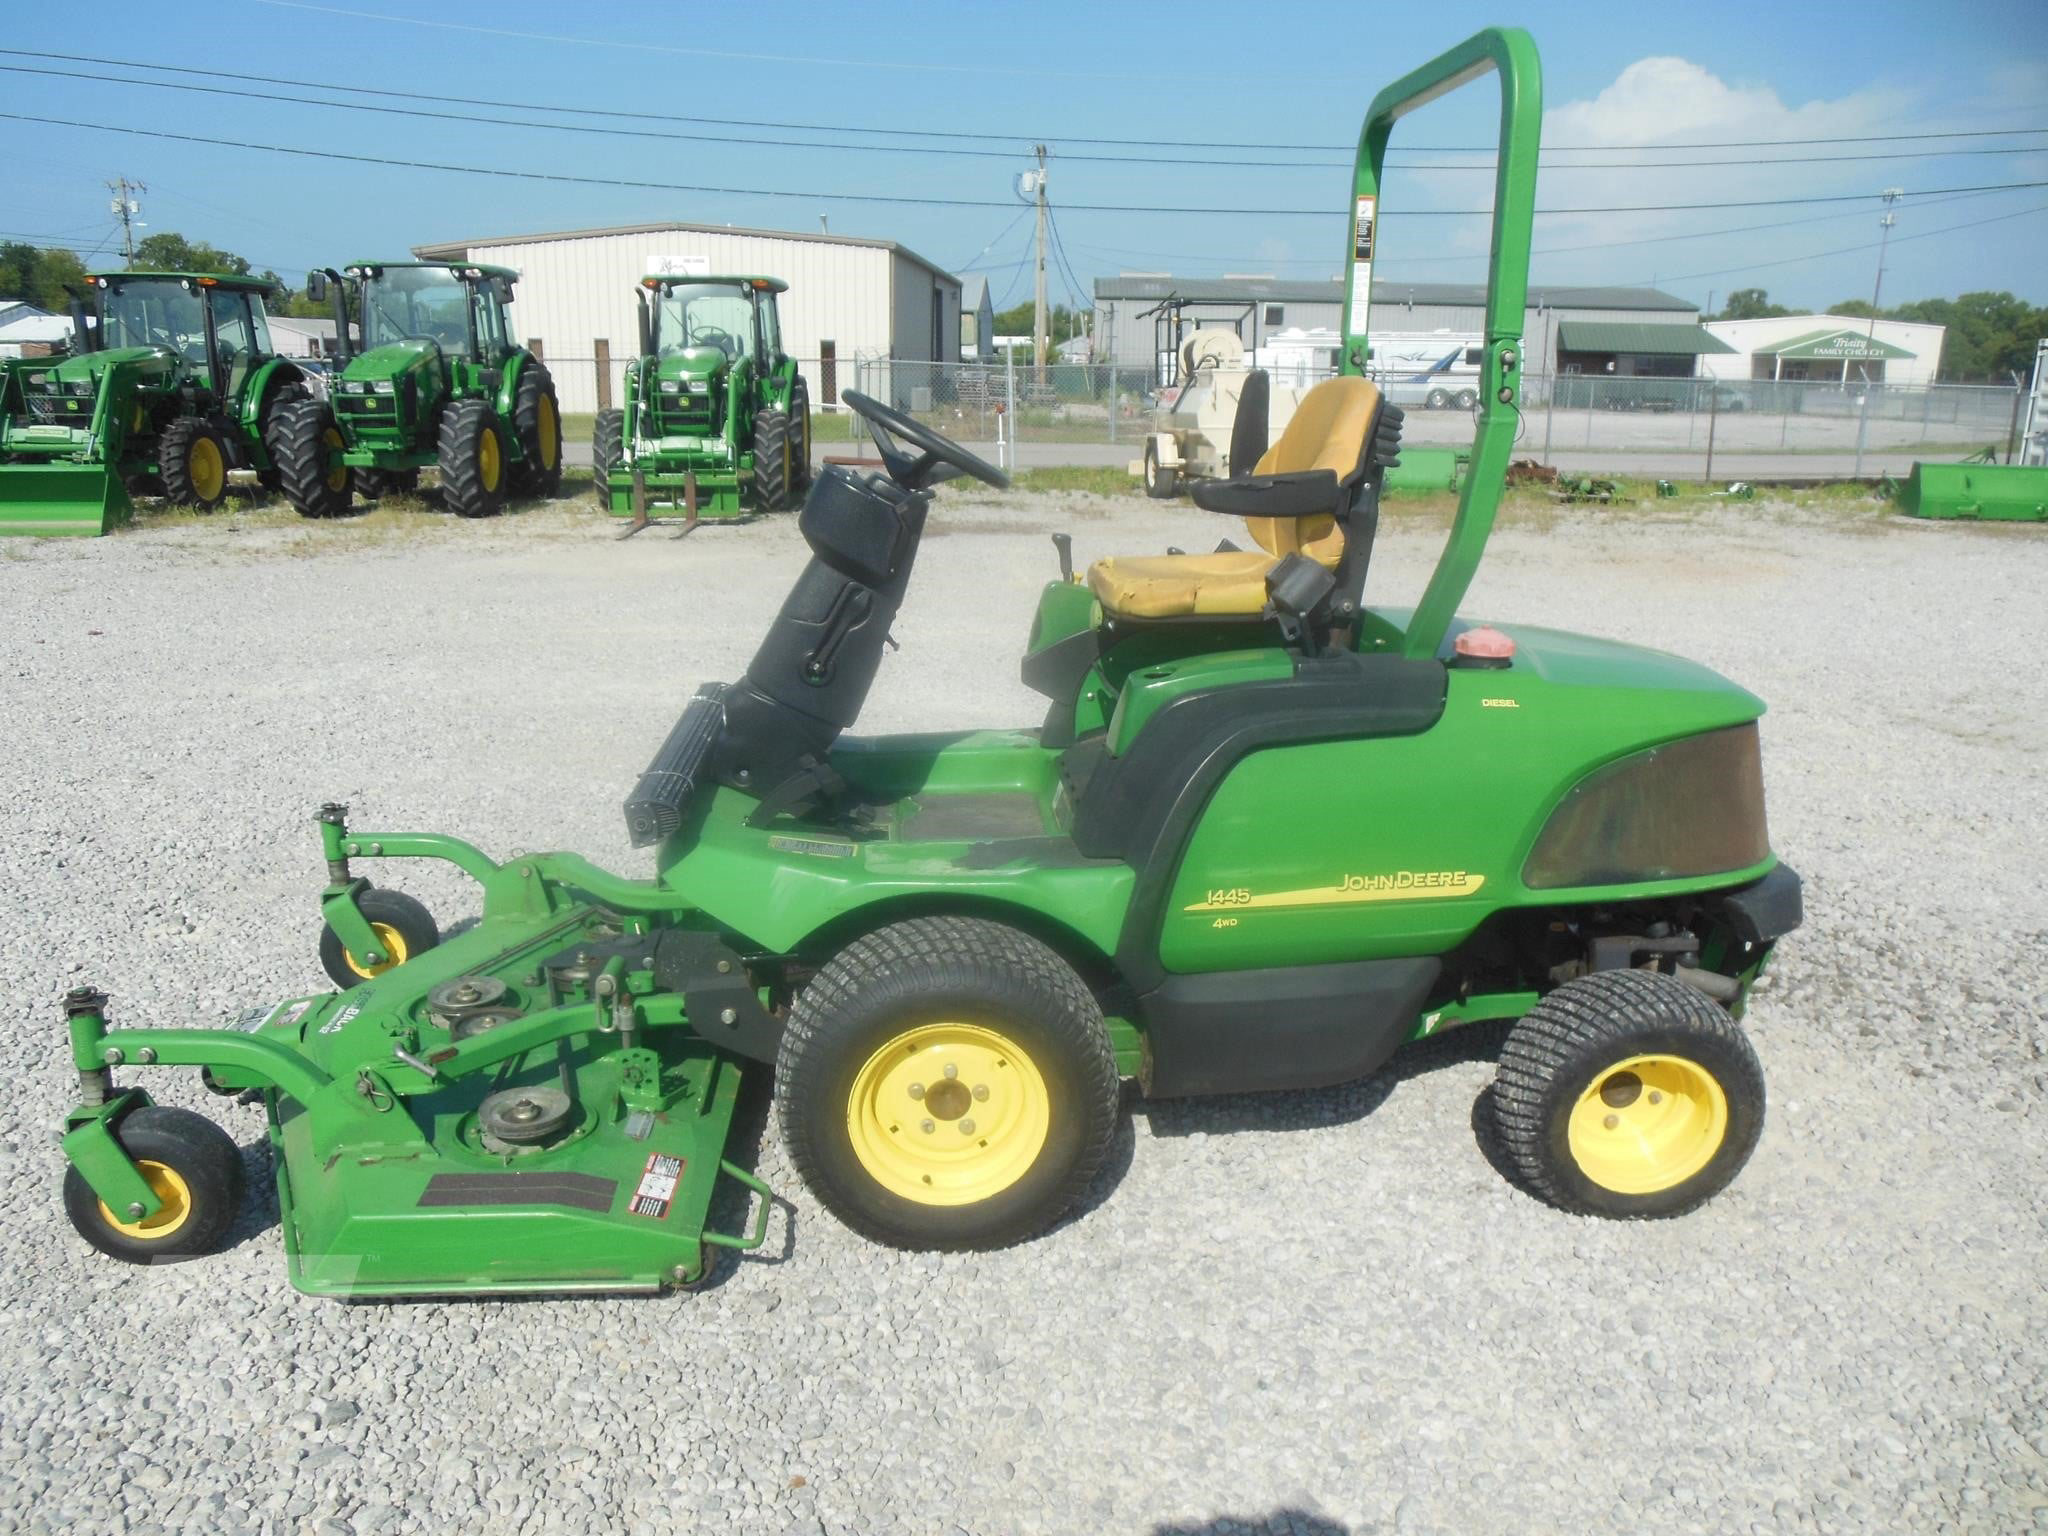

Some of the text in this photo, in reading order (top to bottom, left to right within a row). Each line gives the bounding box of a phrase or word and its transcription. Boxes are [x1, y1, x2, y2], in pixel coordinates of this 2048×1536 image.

[1833, 337, 1867, 349] Trinity
[1814, 348, 1843, 356] FAMILY
[1482, 699, 1520, 707] DIESEL
[1207, 889, 1250, 904] 1445
[1212, 918, 1238, 929] 4WD
